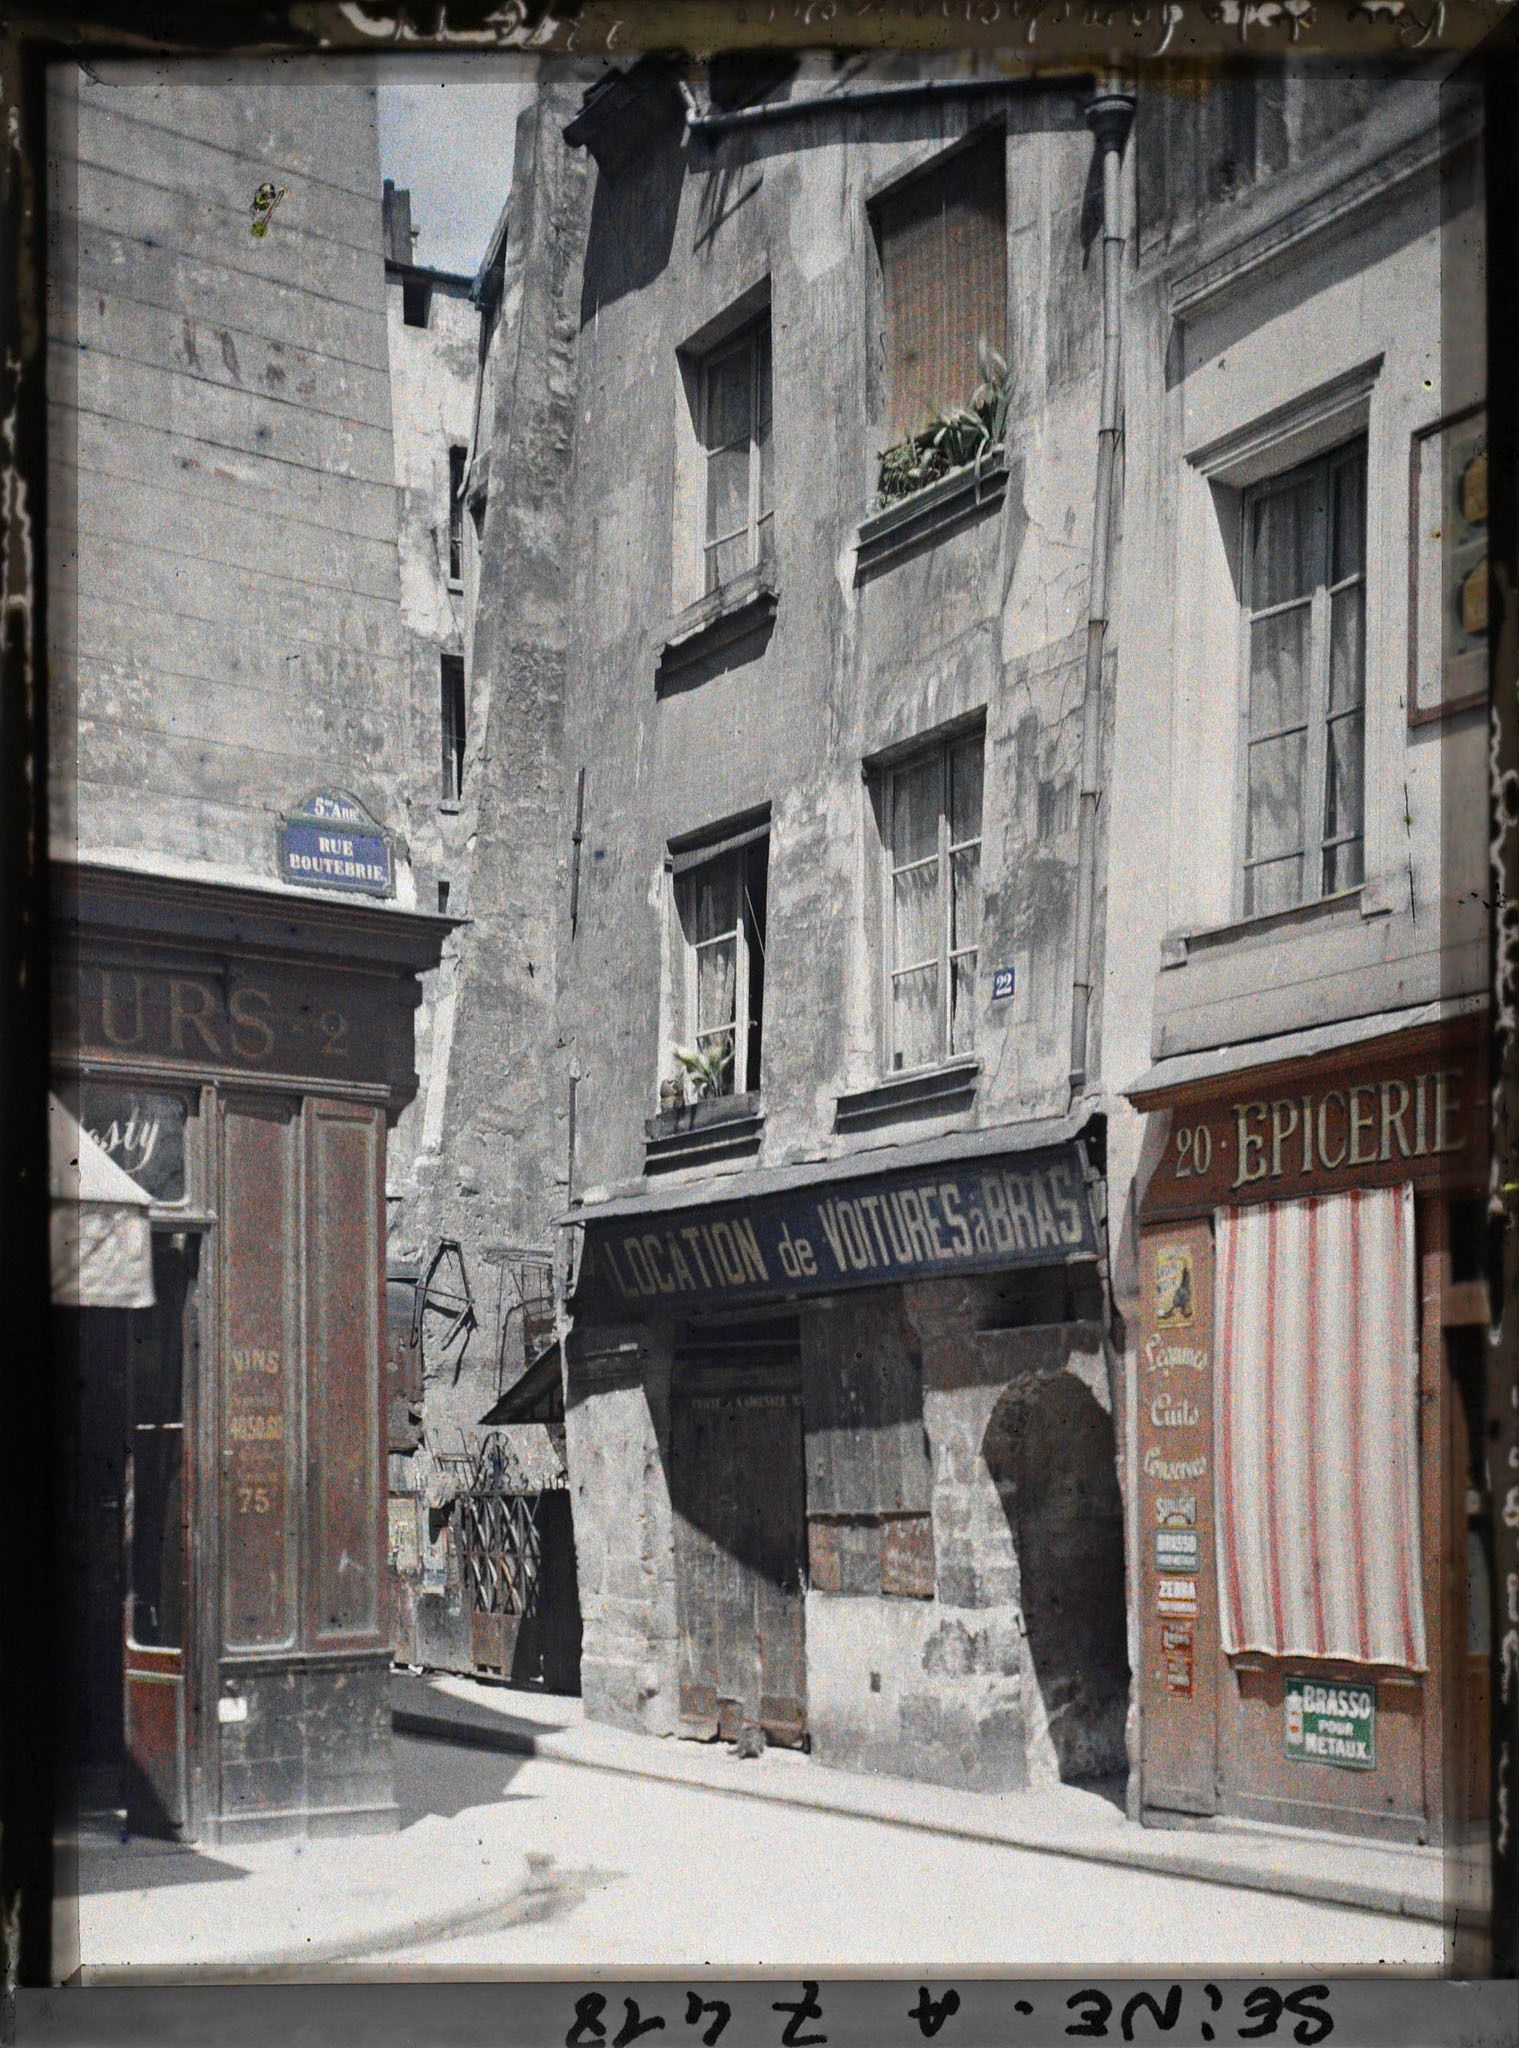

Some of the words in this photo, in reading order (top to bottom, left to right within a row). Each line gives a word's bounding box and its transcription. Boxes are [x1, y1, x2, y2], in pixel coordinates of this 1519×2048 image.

[319, 837, 353, 856] RUE
[996, 973, 1012, 997] 22
[80, 970, 275, 1060] URS
[1175, 1124, 1213, 1179] 20
[604, 1217, 769, 1298] LOCATION
[777, 1221, 818, 1279] de
[816, 1182, 974, 1273] VOITURES
[981, 1163, 1084, 1254] BRAS
[1303, 1684, 1371, 1720] BRASSO
[1318, 1719, 1354, 1737] POUR
